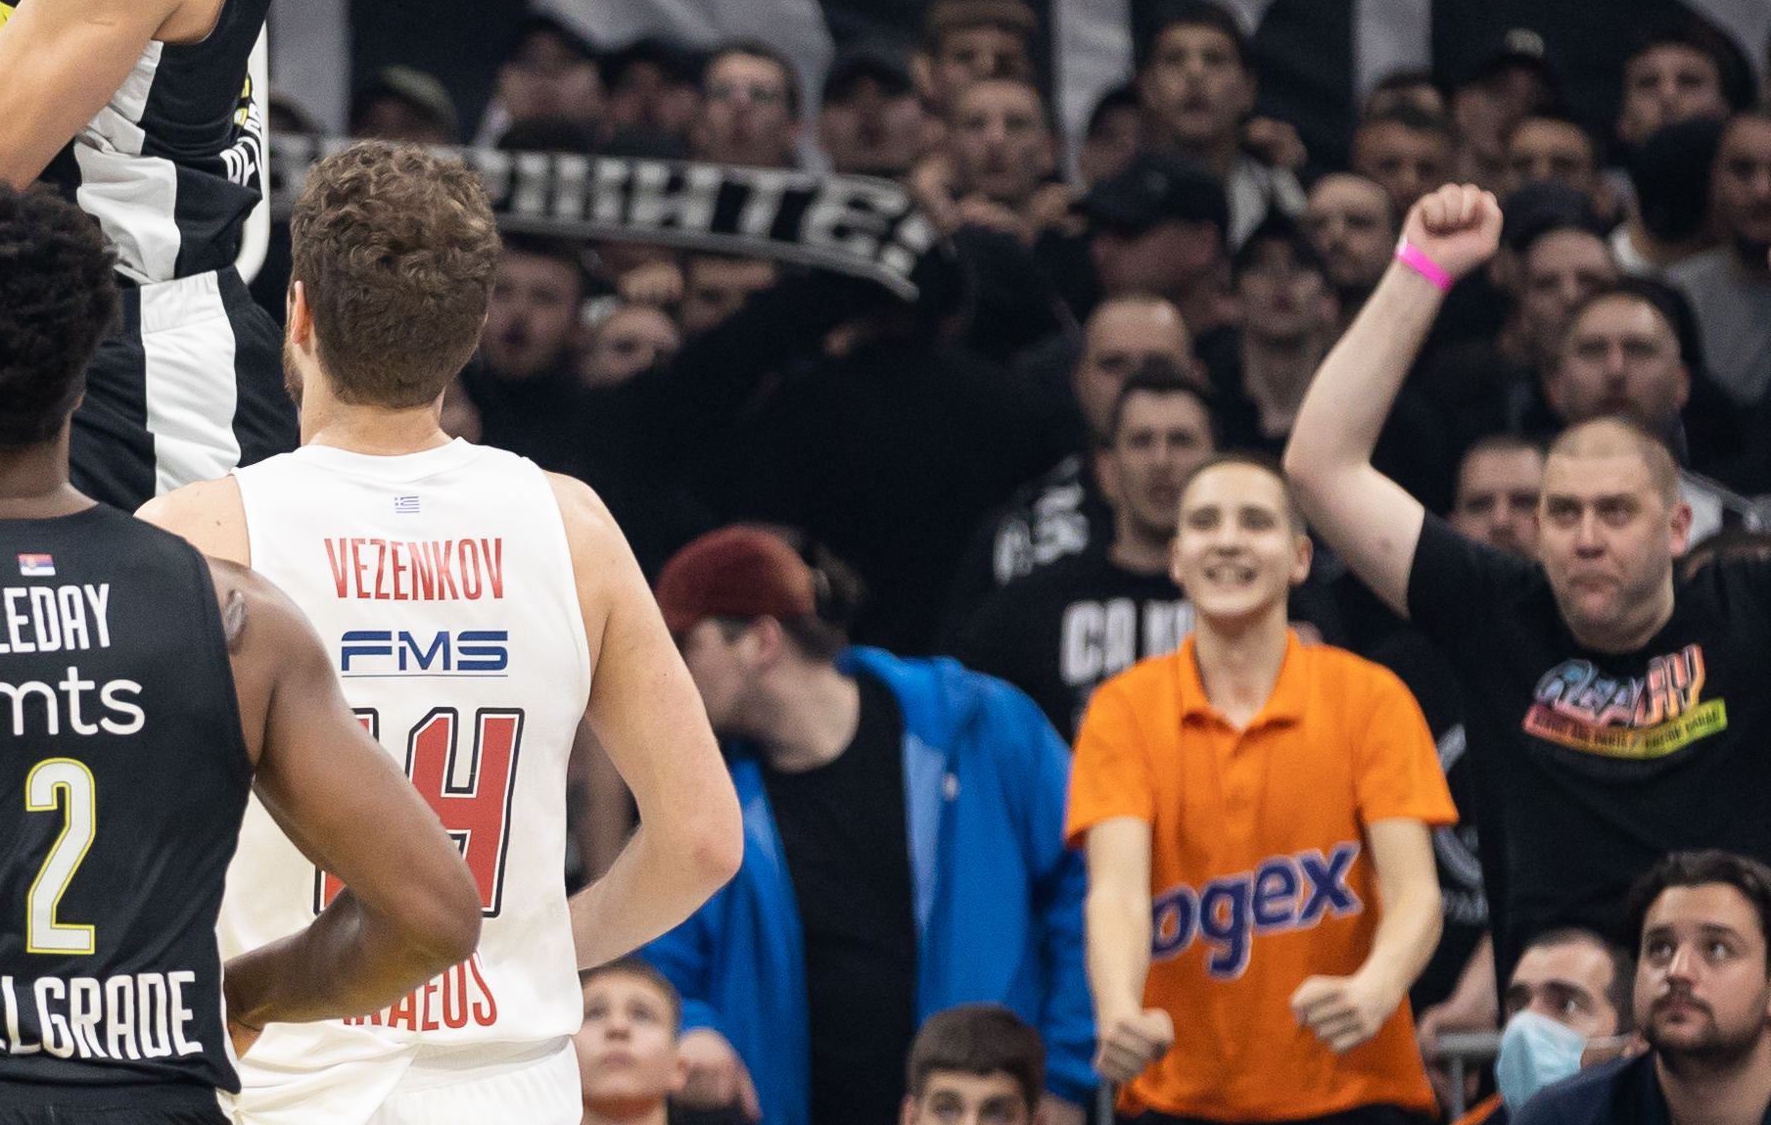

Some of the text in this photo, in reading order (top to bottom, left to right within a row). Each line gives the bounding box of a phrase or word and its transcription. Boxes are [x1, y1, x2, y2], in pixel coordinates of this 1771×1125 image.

[323, 537, 504, 601] VEZENKOV
[340, 630, 509, 672] FMS
[25, 756, 97, 955] 2
